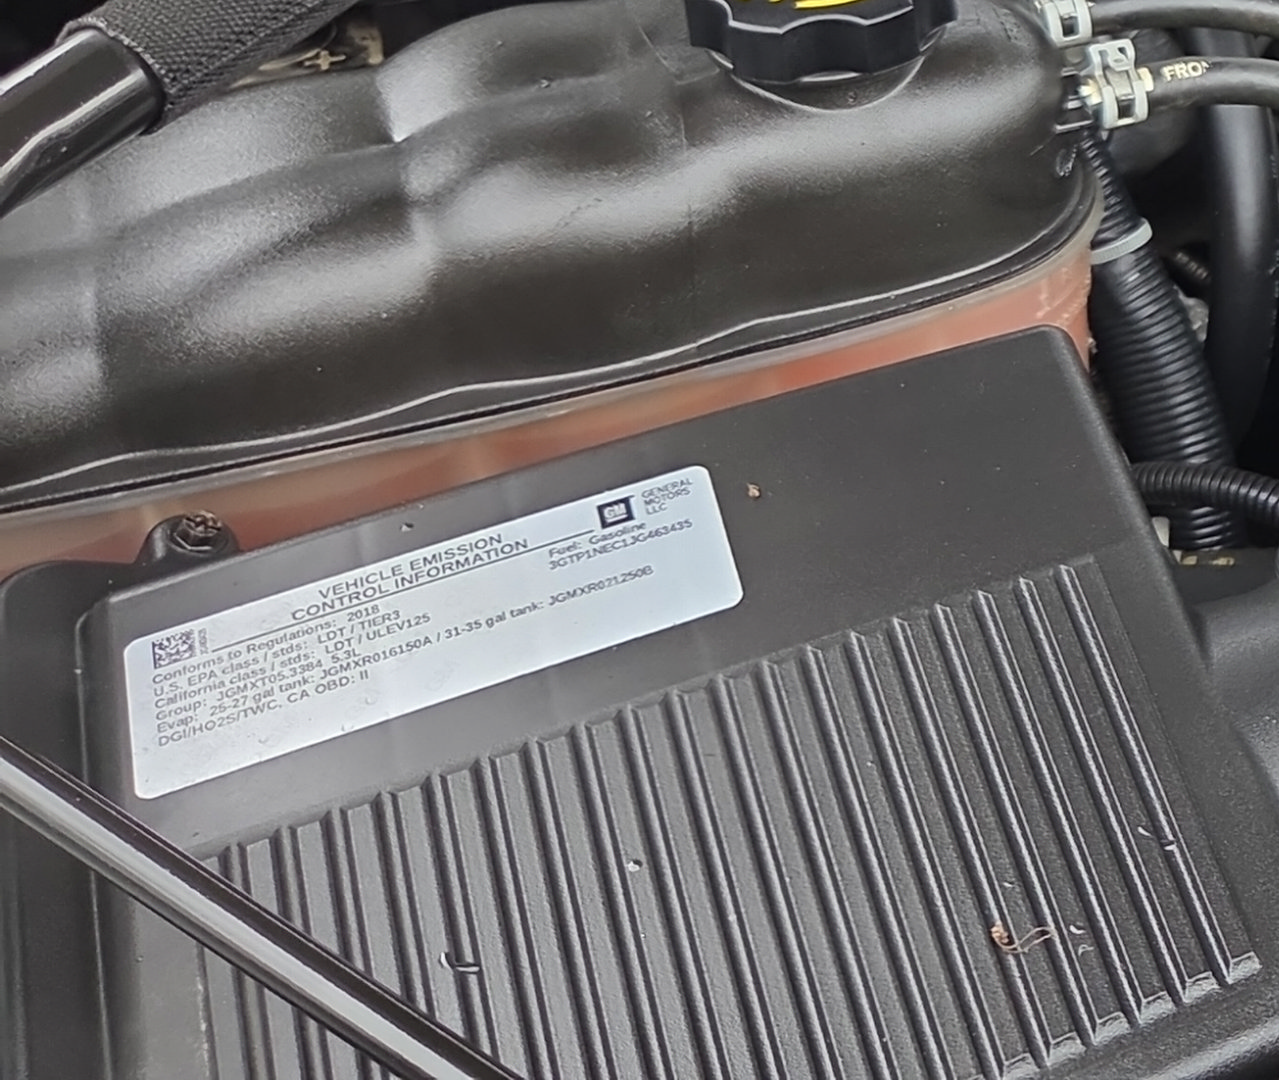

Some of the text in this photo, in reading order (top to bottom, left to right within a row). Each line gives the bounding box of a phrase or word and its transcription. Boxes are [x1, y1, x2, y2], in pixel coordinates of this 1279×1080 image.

[603, 502, 627, 519] GM
[640, 476, 693, 499] GENERAL
[643, 486, 690, 507] MOTORS
[645, 501, 667, 515] LLC
[317, 532, 503, 599] VEHICLE EMISSION
[587, 519, 646, 545] Gasoline
[289, 538, 529, 622] CONTROL INFORMATION
[151, 603, 381, 686] Conforms to Regulations: 2018
[153, 609, 401, 698] U.S. EPA class / stds: LDT / TIER3
[154, 612, 431, 709] California class / stds: LDT / ULEV125
[157, 712, 199, 734] Evap:
[207, 694, 250, 717] 25-27
[250, 686, 276, 705] gal
[277, 673, 316, 693] tank:
[442, 618, 483, 640] 31-35
[483, 610, 508, 628] gal
[508, 598, 544, 618] tank:
[155, 696, 208, 722] Group:
[329, 646, 361, 664] 5.3L
[285, 688, 310, 704] CA
[313, 673, 356, 695] OBD:
[358, 669, 369, 680] II
